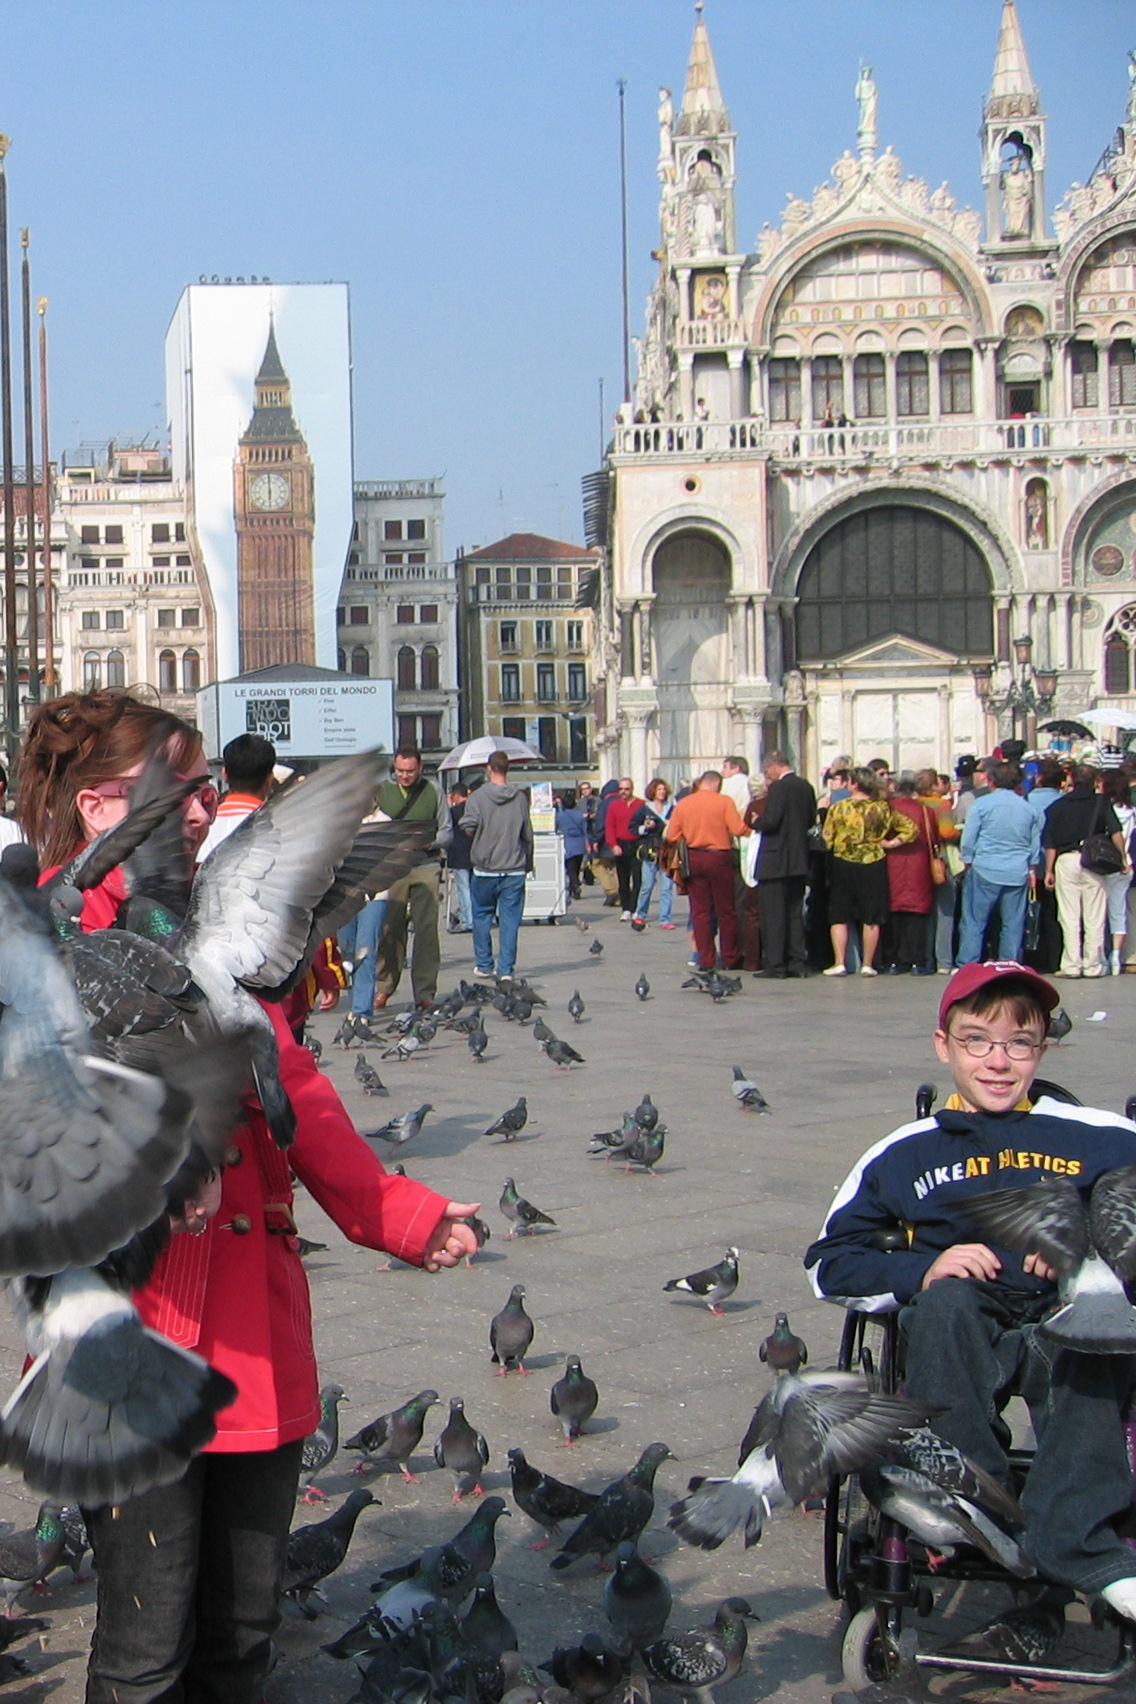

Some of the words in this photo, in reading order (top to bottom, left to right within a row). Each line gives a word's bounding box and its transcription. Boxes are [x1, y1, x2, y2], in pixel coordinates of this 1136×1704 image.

[234, 688, 246, 698] LE
[249, 688, 286, 698] GRANDI
[289, 687, 317, 697] TORRI
[320, 686, 338, 696] DEL
[341, 685, 377, 695] MONDO
[913, 1162, 965, 1200] NIKE
